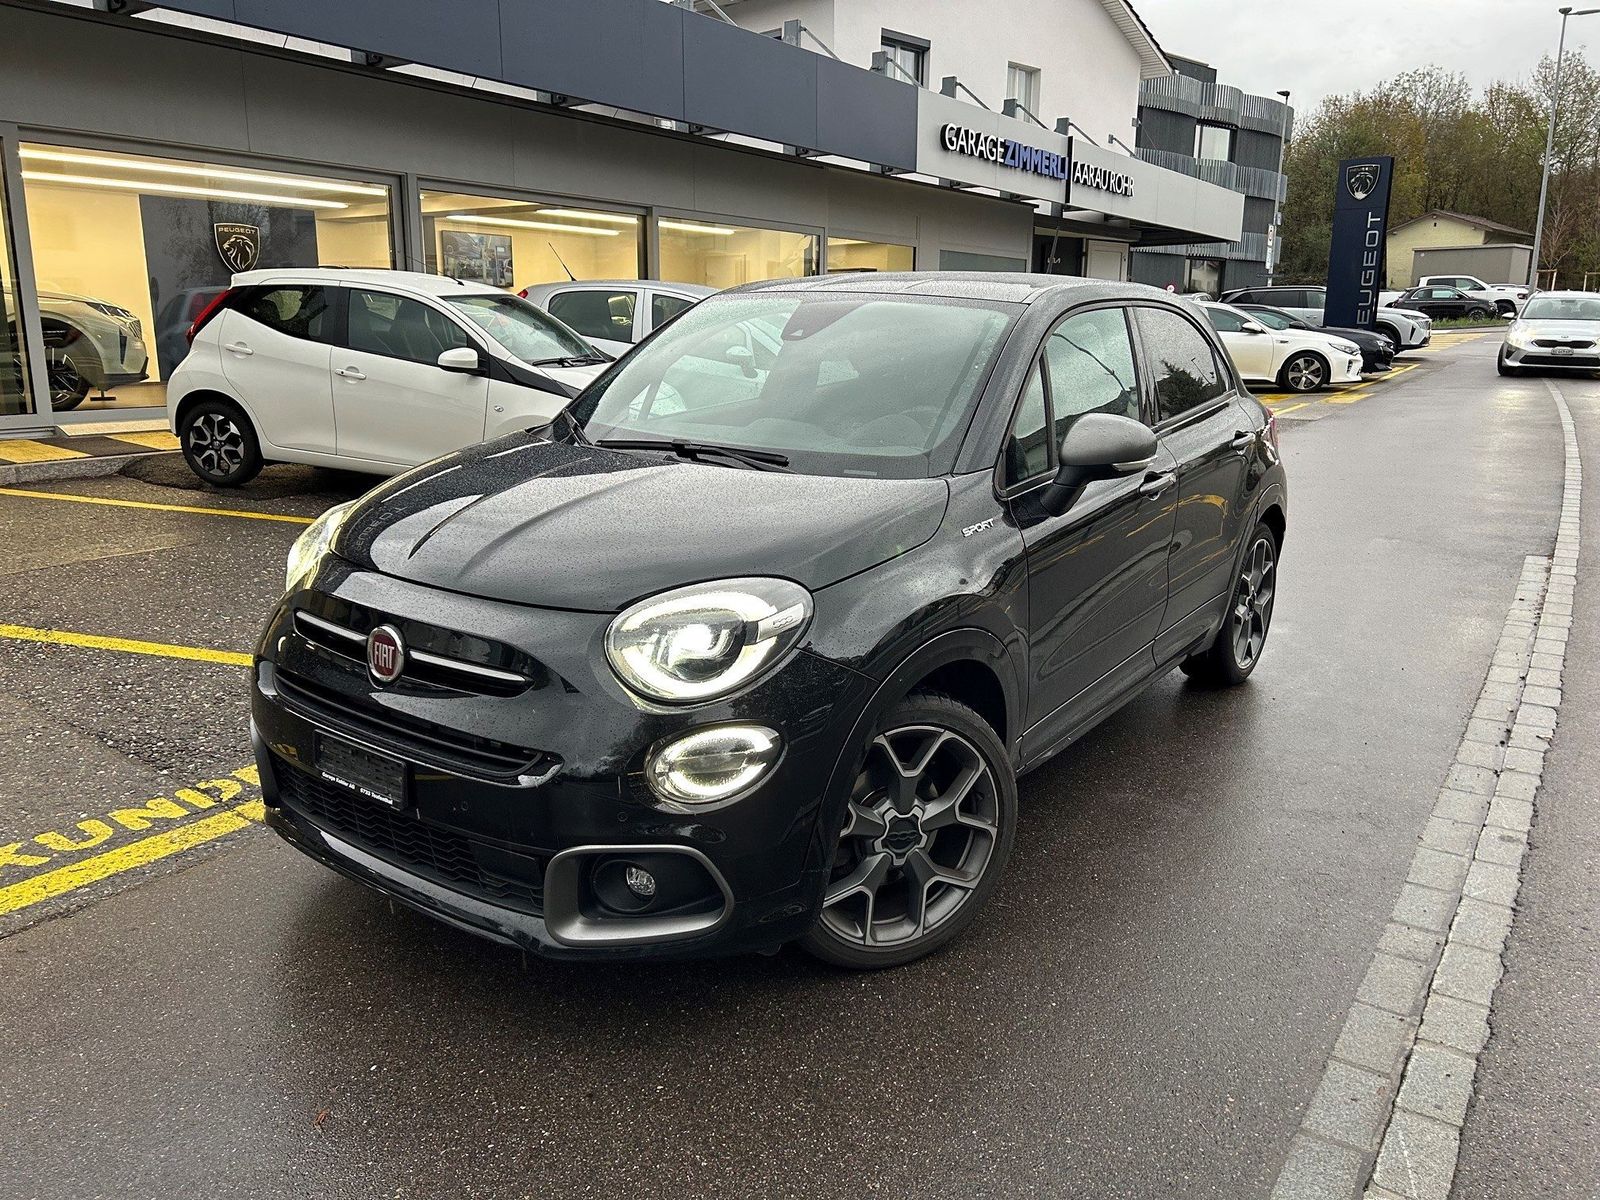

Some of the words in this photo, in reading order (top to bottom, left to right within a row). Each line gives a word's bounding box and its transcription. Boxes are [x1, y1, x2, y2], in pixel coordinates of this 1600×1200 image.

[218, 227, 256, 235] PEUGEOT
[1356, 211, 1381, 326] EUGEOT
[961, 518, 994, 538] SPORT
[374, 641, 395, 670] FIAT
